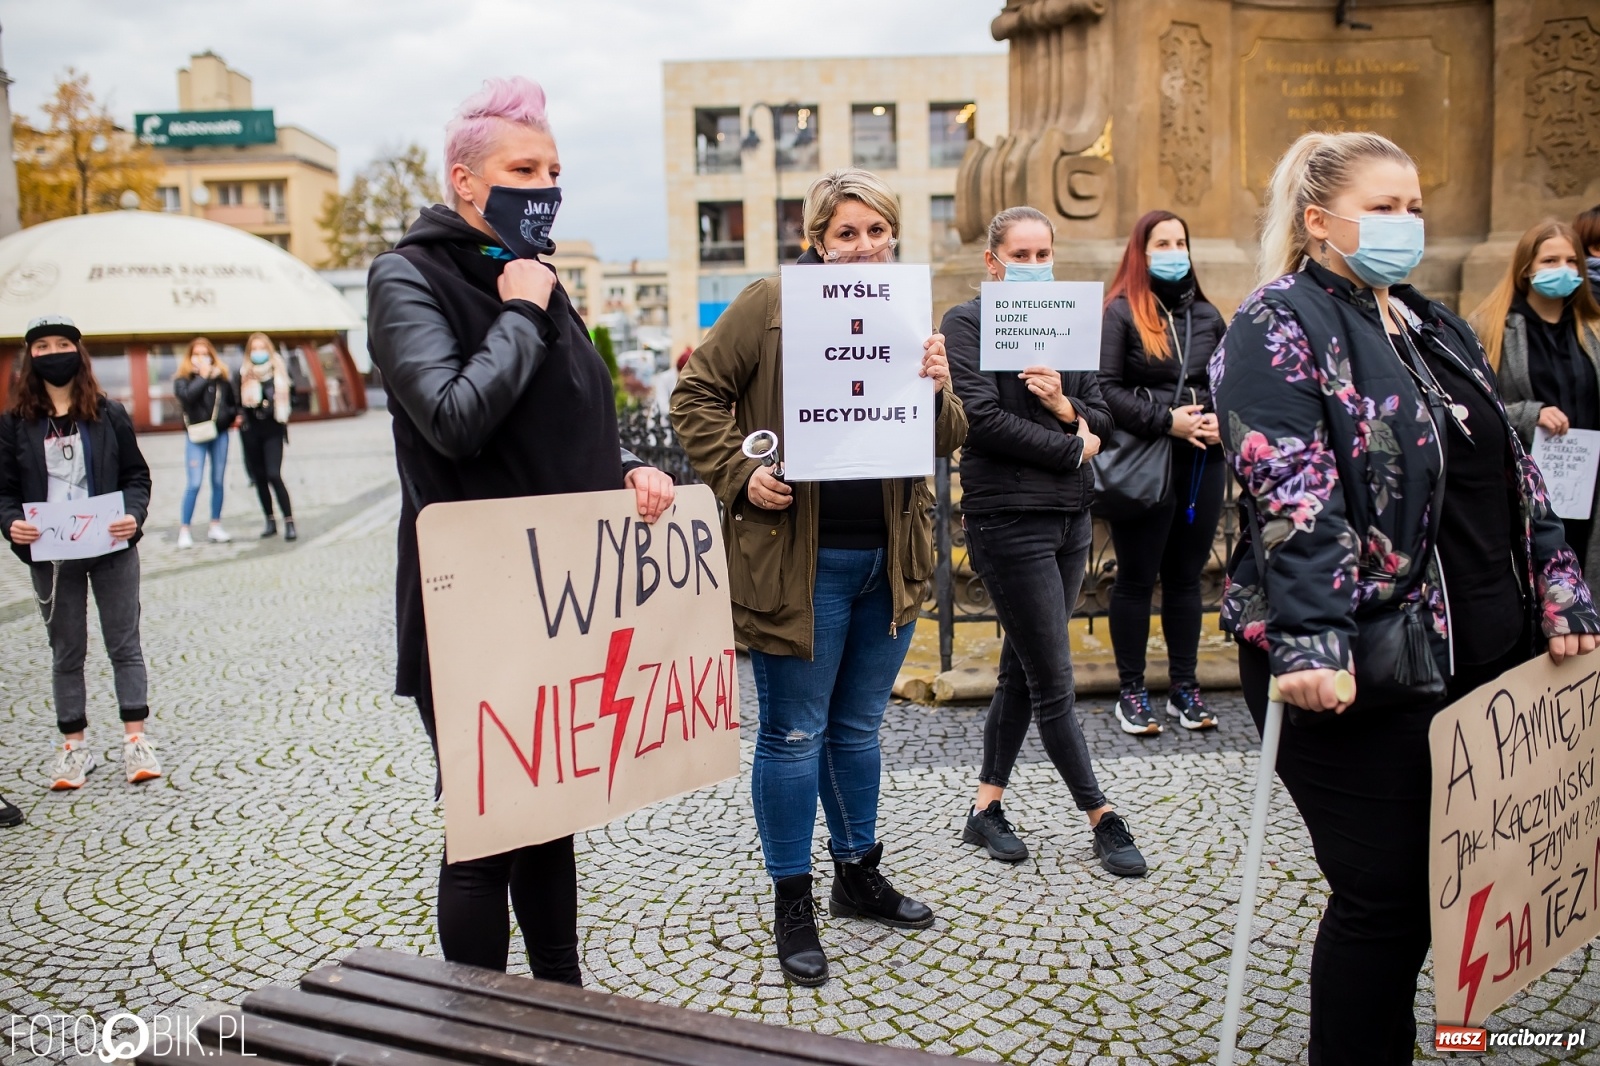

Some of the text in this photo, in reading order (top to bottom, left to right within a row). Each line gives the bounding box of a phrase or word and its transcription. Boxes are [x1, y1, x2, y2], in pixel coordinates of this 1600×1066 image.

[524, 200, 551, 216] JACK
[822, 280, 890, 301] MYŚLĘ
[995, 300, 1076, 309] BO INTELIGENTNI
[995, 314, 1028, 322] LUDZIE
[824, 346, 891, 363] CZUJĘ
[995, 341, 1045, 351] CHUJ !!!
[799, 406, 906, 424] DECYDUJĘ
[526, 504, 719, 639] WYBÓR
[477, 649, 740, 816] NIE ZAKAZ
[1446, 718, 1477, 816] A
[1439, 829, 1488, 910] JAK
[1491, 747, 1595, 851] KACZYŃSKI
[1527, 810, 1579, 877] FAJNY
[1492, 901, 1533, 983] JA
[1541, 862, 1588, 948] TEŻ
